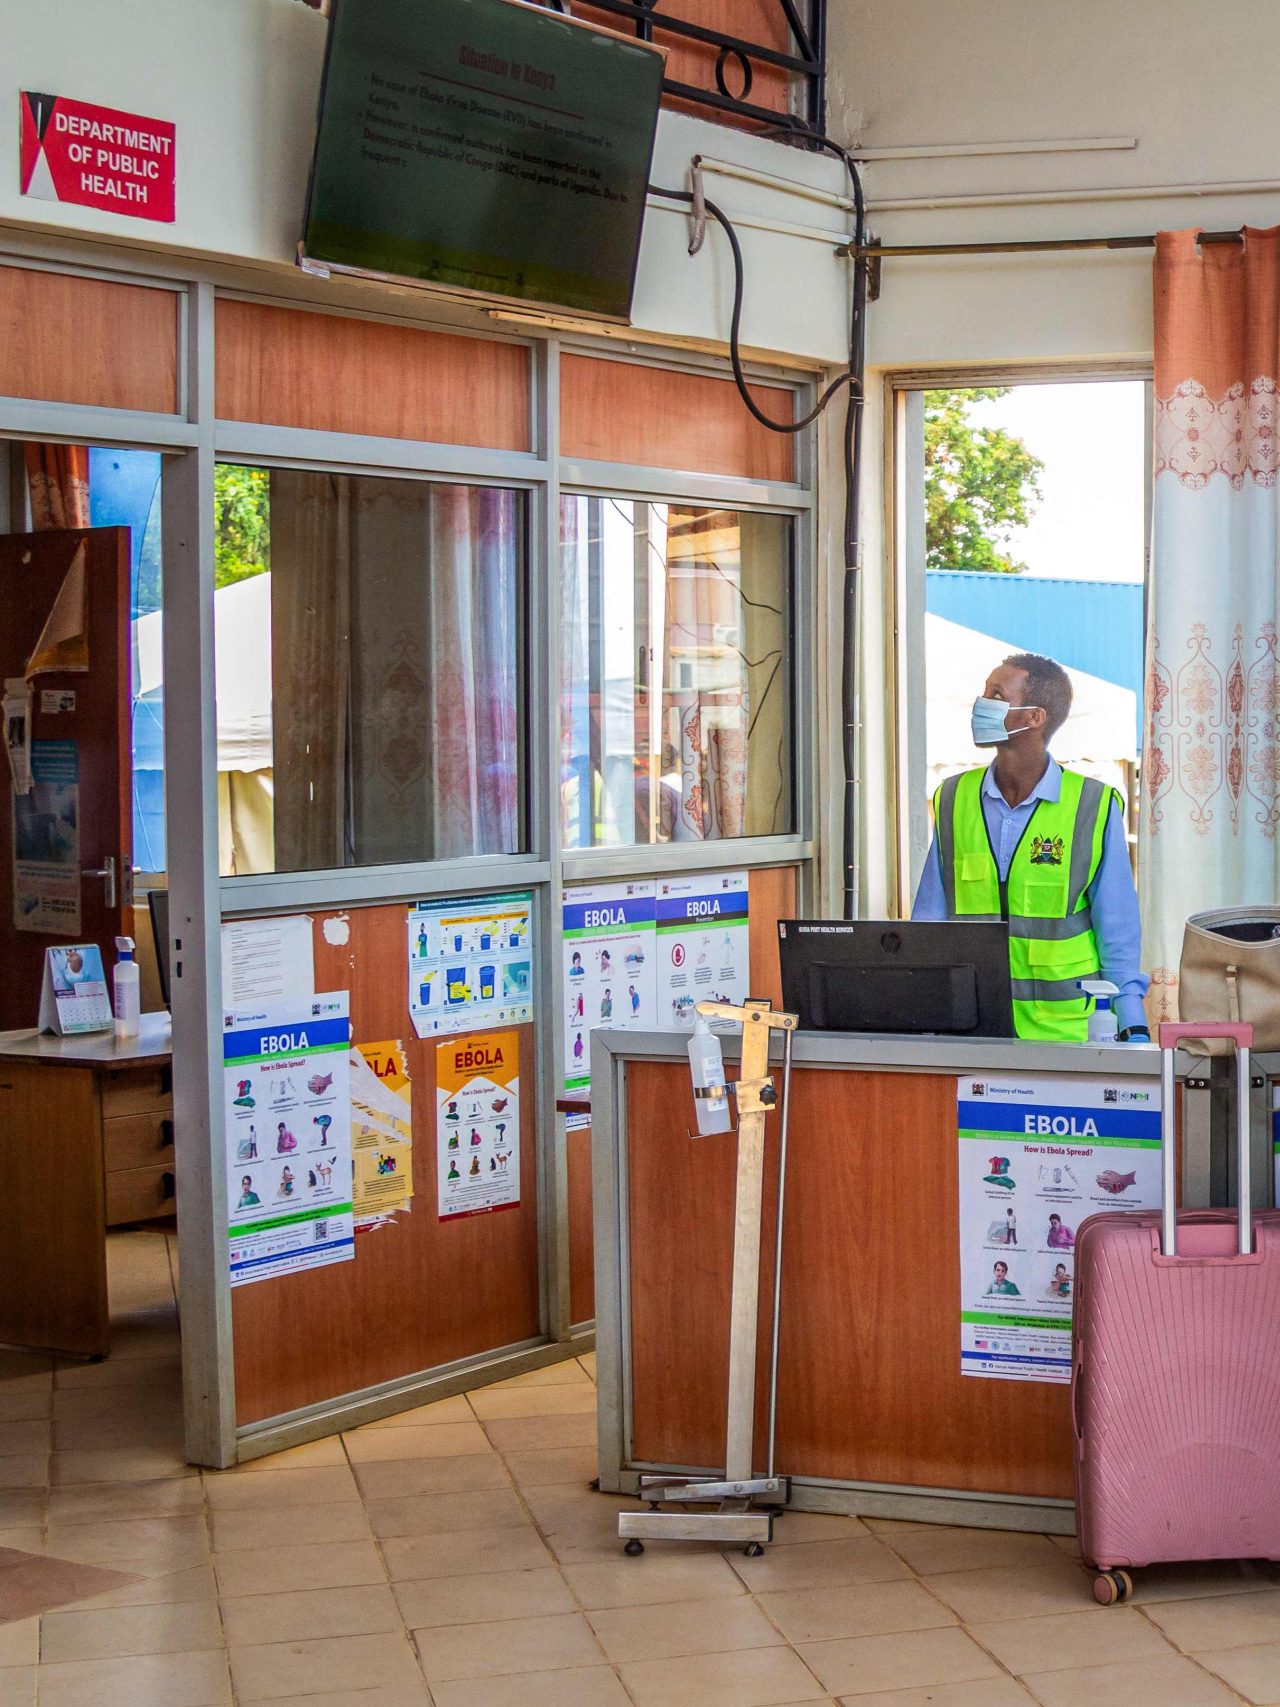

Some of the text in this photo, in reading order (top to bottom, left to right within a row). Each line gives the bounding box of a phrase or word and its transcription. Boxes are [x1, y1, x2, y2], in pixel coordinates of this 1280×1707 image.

[56, 112, 171, 155] DEPARTMENT
[69, 143, 159, 179] OF PUBLIC
[81, 172, 148, 203] HEALTH
[584, 907, 626, 928] EBOLA
[686, 899, 721, 917] EBOLA
[260, 1031, 310, 1055] EBOLA
[455, 1047, 504, 1069] EBOLA
[989, 1087, 1011, 1096] Ministry
[1024, 1114, 1099, 1137] EBOLA
[1024, 1145, 1093, 1157] How is Ebola Spread?
